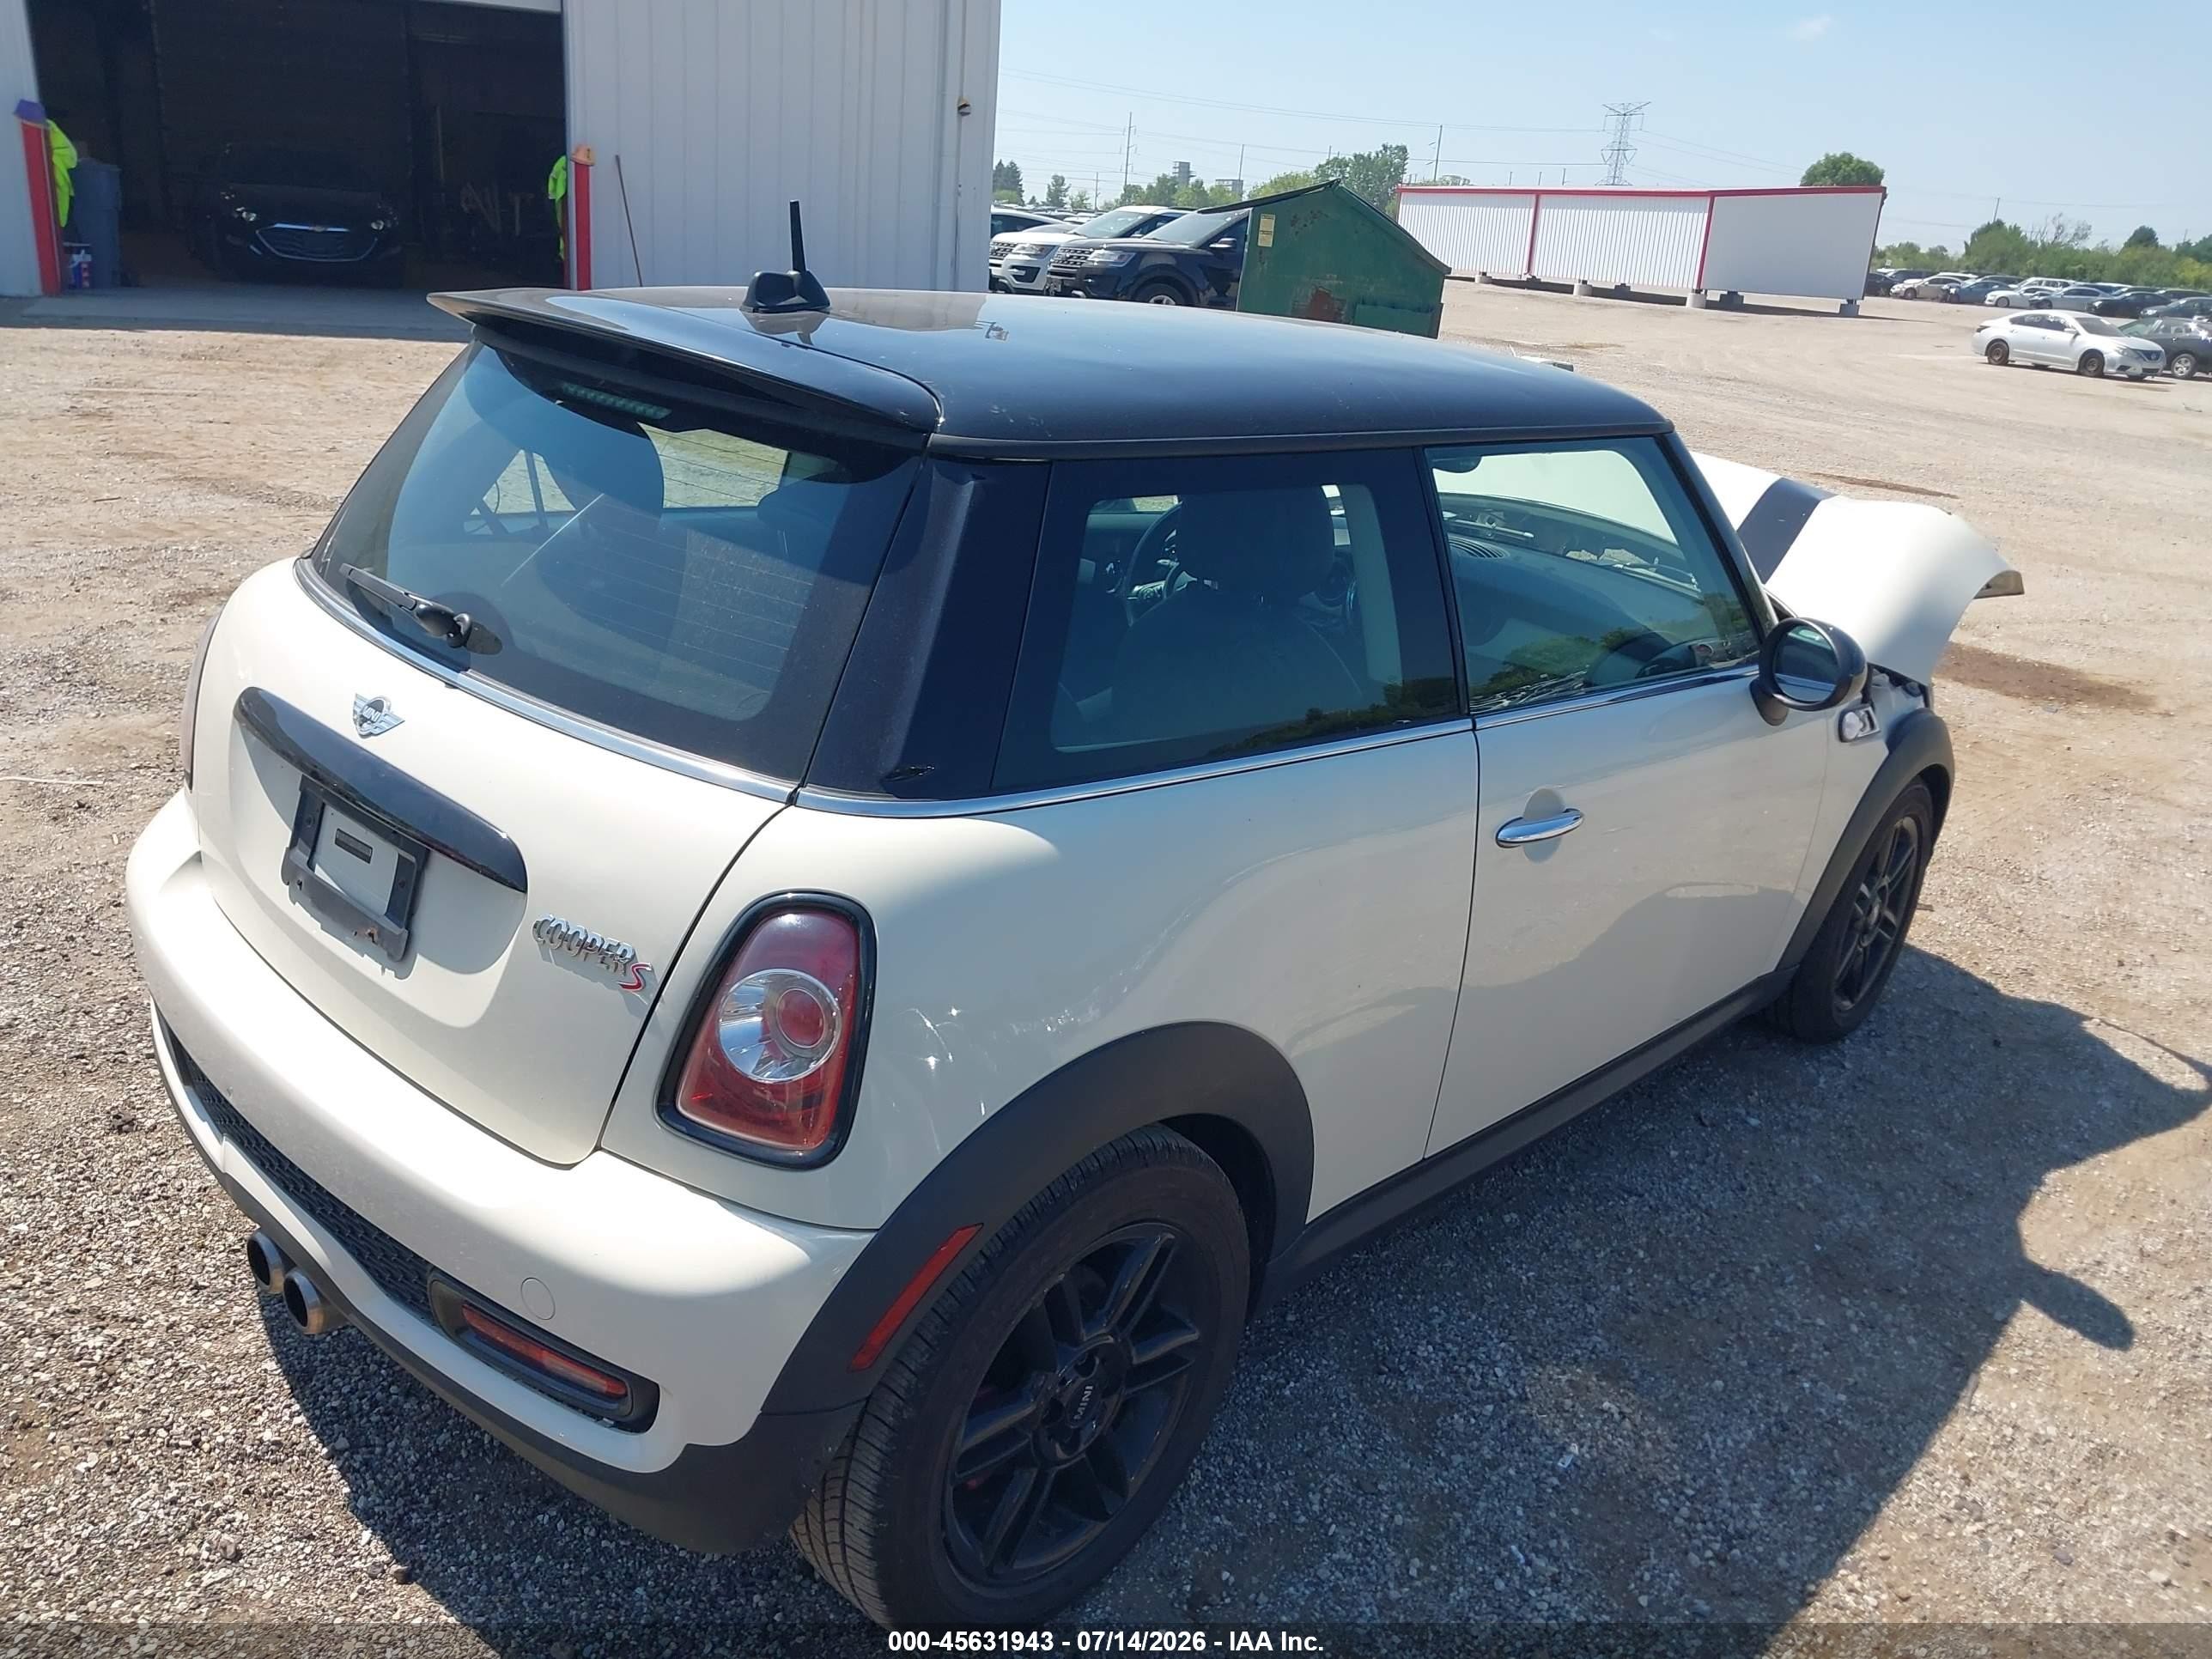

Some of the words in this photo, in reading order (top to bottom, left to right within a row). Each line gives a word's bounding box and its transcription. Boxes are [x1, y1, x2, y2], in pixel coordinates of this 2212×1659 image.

[362, 705, 381, 722] MINI
[532, 914, 637, 973] COOPER
[617, 963, 653, 993] S
[1073, 1385, 1093, 1420] MINI
